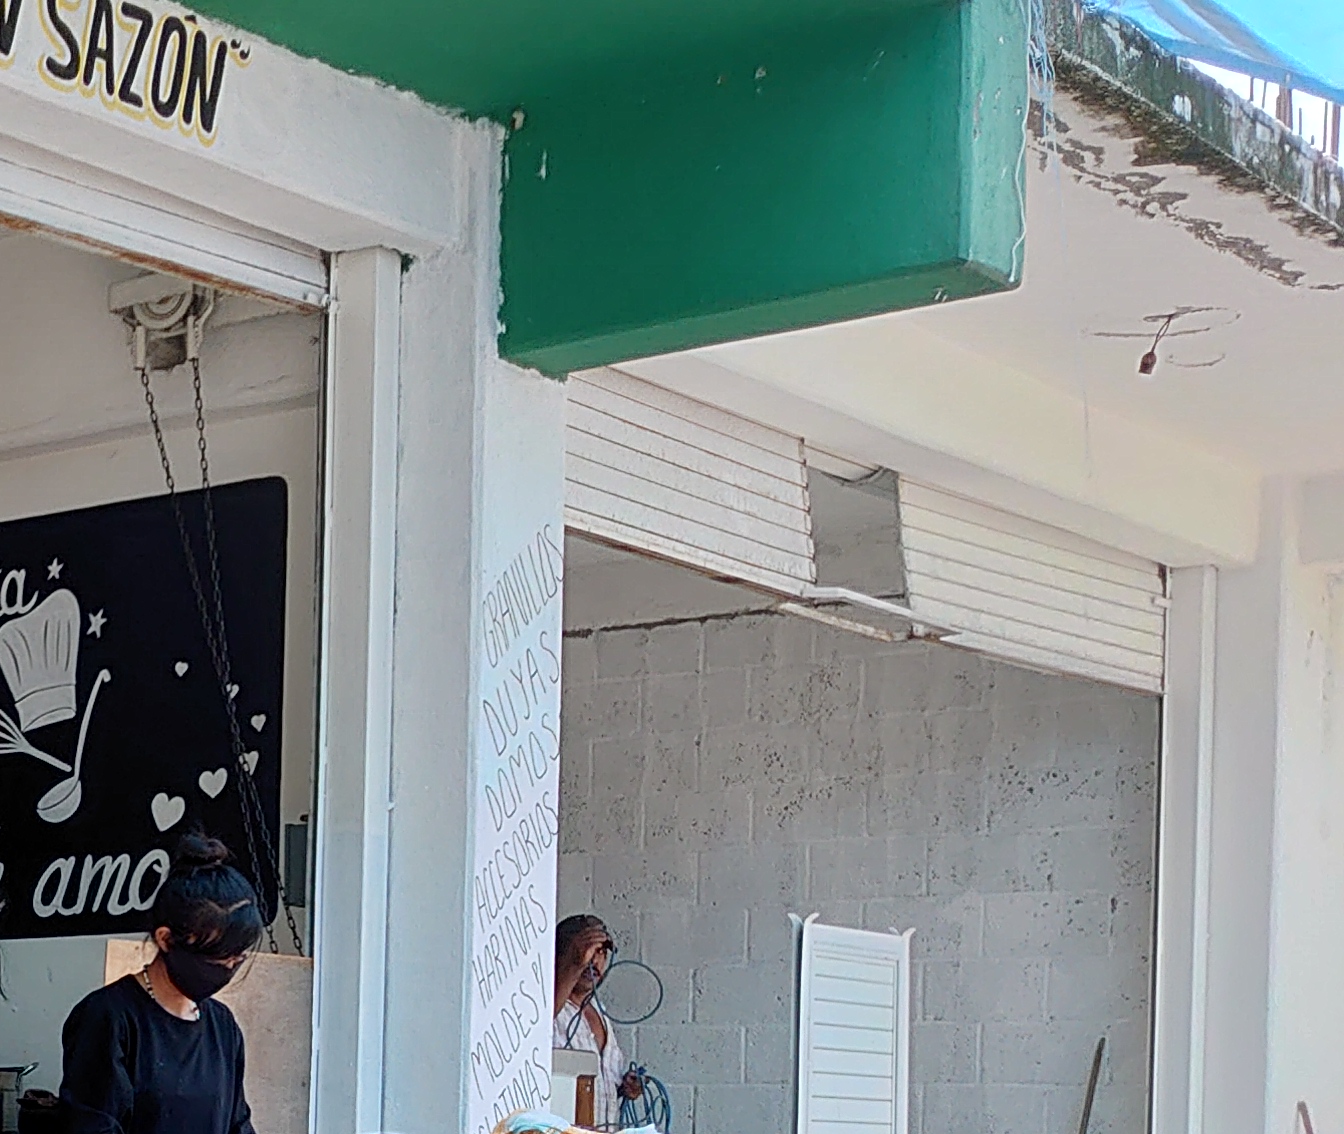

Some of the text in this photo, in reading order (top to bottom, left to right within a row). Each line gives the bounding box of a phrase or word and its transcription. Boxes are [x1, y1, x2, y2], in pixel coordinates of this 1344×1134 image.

[482, 523, 563, 669] GRANILLOS
[482, 630, 560, 757] DUYAS
[484, 712, 560, 833] DOMOS
[32, 848, 171, 918] amo
[471, 883, 548, 1010] HARINAS
[470, 986, 539, 1100] MOLDES
